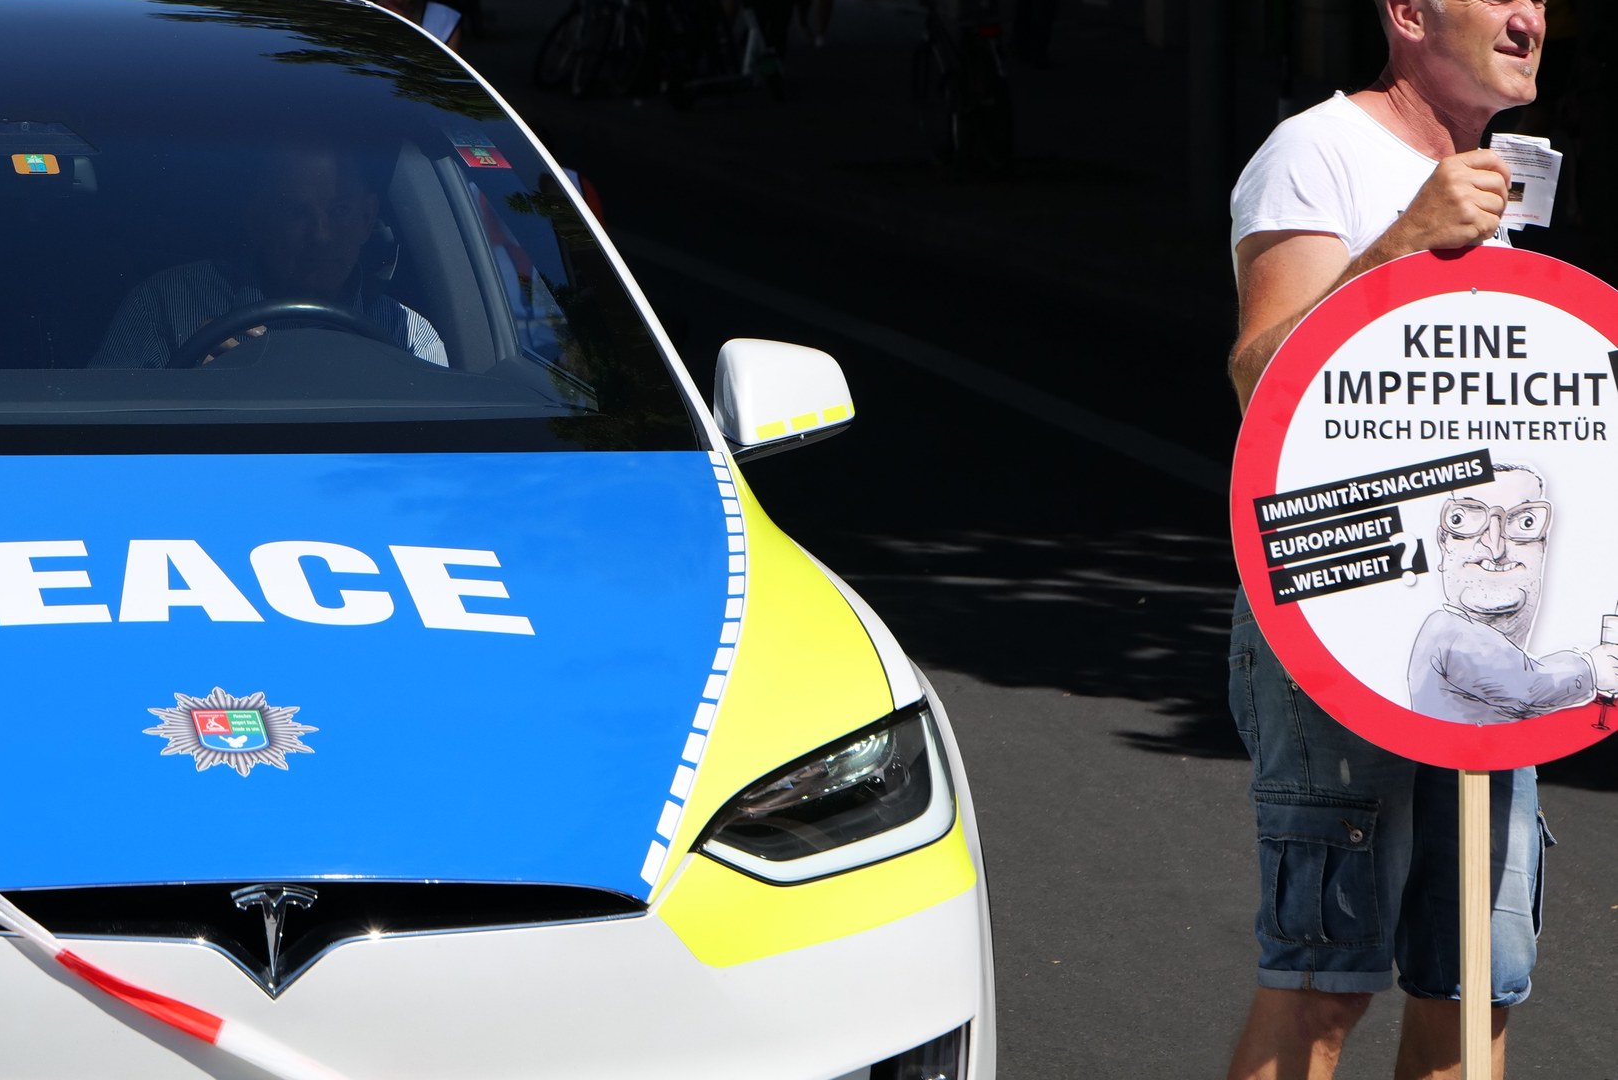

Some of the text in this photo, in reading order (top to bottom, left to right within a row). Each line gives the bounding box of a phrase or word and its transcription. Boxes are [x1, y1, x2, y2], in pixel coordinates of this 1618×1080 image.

[476, 156, 497, 165] 20
[1403, 324, 1528, 359] KEINE
[1324, 370, 1608, 406] IMPFPFLICHT
[1325, 417, 1607, 441] DURCH DIE HINTERTÜR
[1261, 459, 1483, 522] IMMUNITÄTSNACHWEIS
[1269, 516, 1393, 558] EUROPAWEIT
